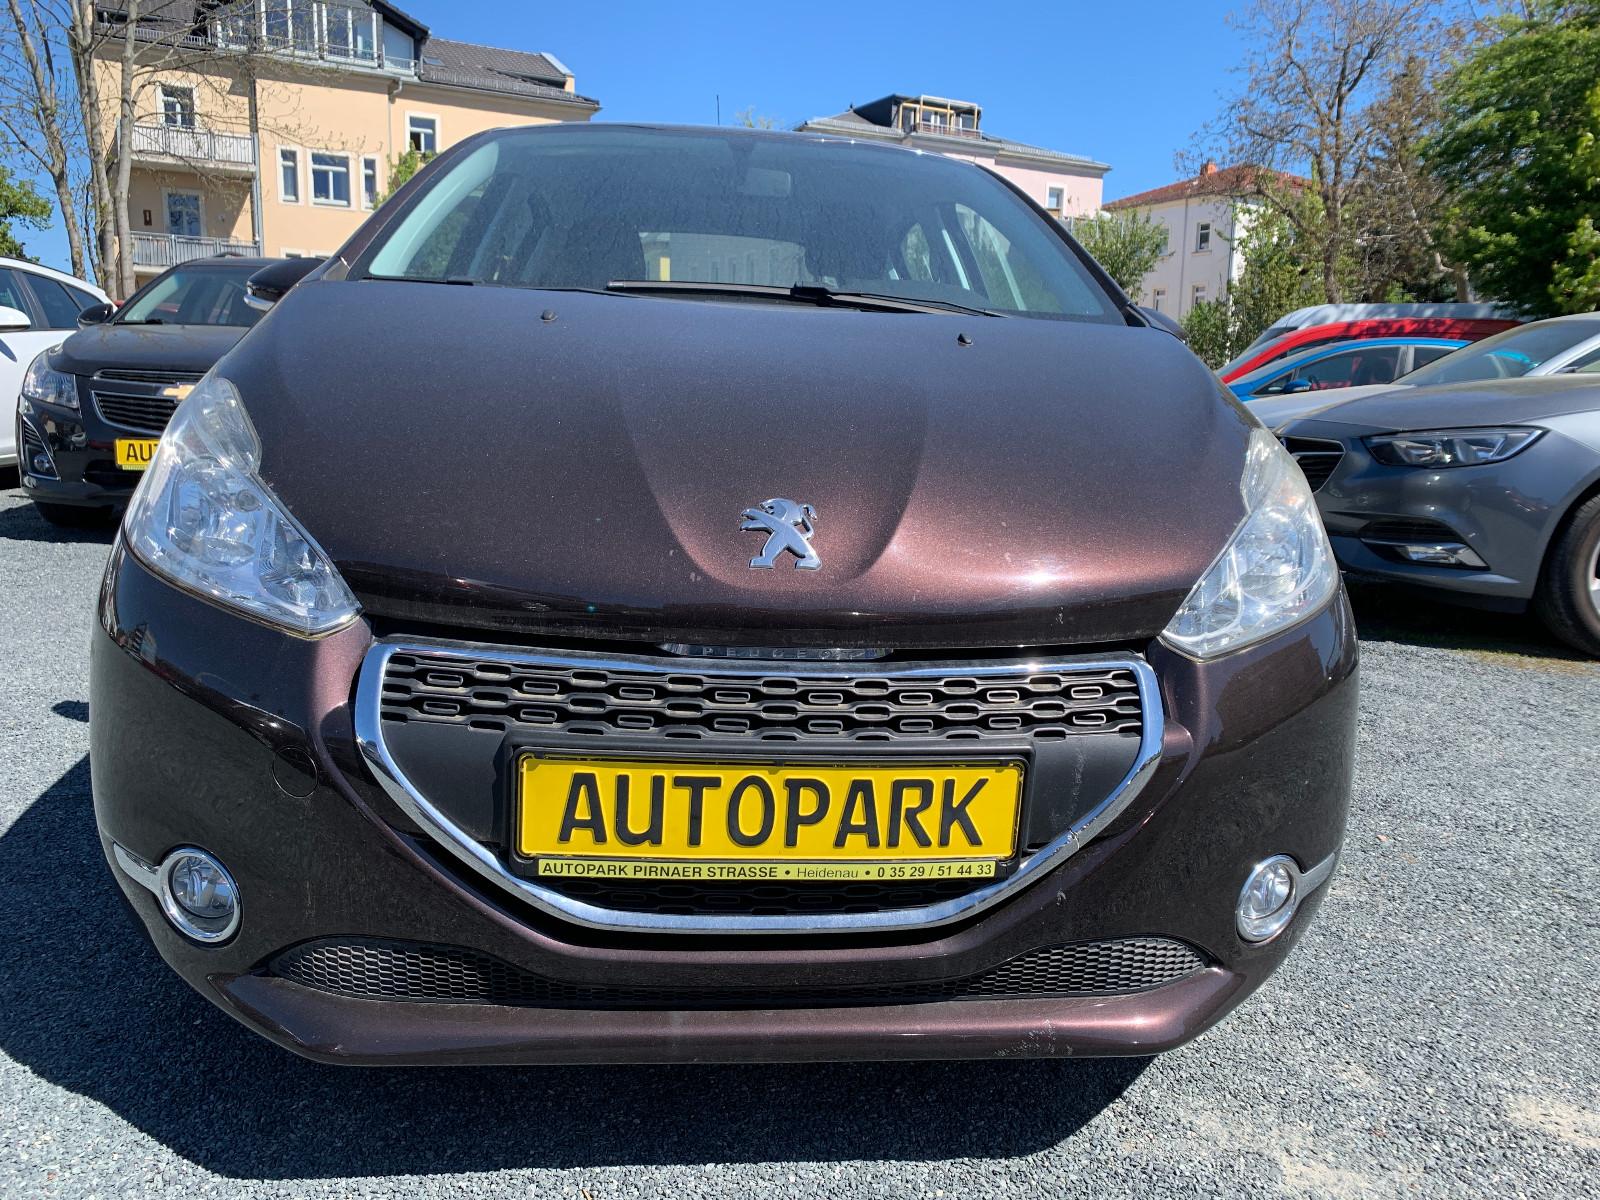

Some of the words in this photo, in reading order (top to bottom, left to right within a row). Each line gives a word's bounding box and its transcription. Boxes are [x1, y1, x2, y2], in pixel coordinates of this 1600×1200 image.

[558, 771, 989, 848] AUTOPARK
[542, 862, 628, 876] AUTOPARK
[633, 865, 703, 878] PIRNAER
[706, 866, 778, 878] STRASSE
[797, 867, 859, 878] Heidenau
[877, 866, 885, 878] 0
[889, 866, 906, 878] 35
[909, 865, 925, 877] 29
[937, 865, 952, 876] 51
[956, 864, 973, 876] 44
[976, 864, 993, 875] 33
